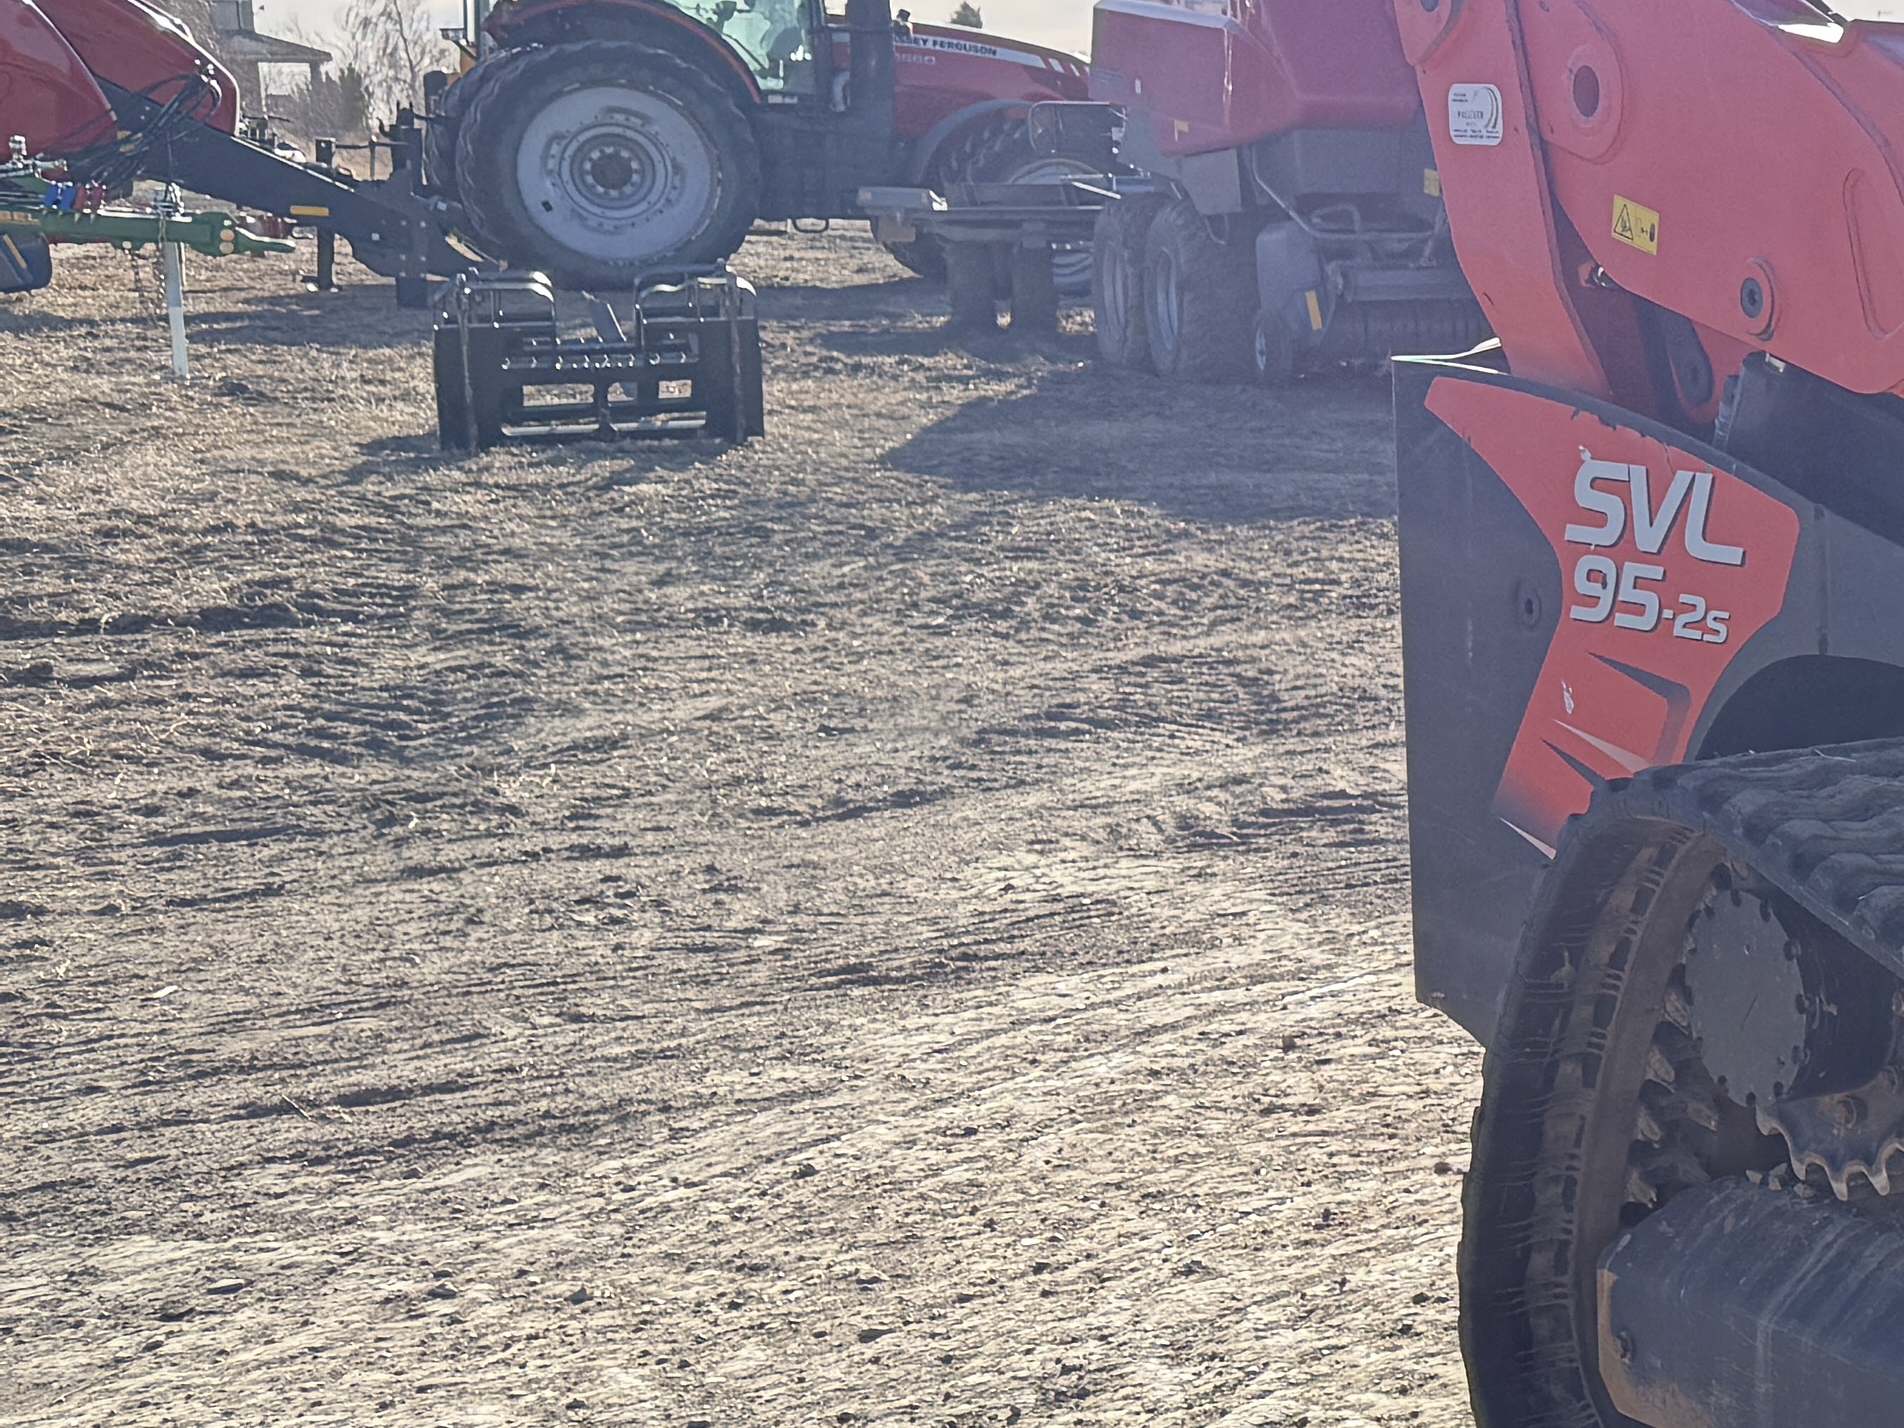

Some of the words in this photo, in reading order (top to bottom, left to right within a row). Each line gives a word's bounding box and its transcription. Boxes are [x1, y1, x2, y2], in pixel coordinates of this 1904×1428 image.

[932, 38, 998, 57] FERGUSON
[1563, 458, 1747, 567] SVL
[1568, 553, 1732, 645] 95-2s
